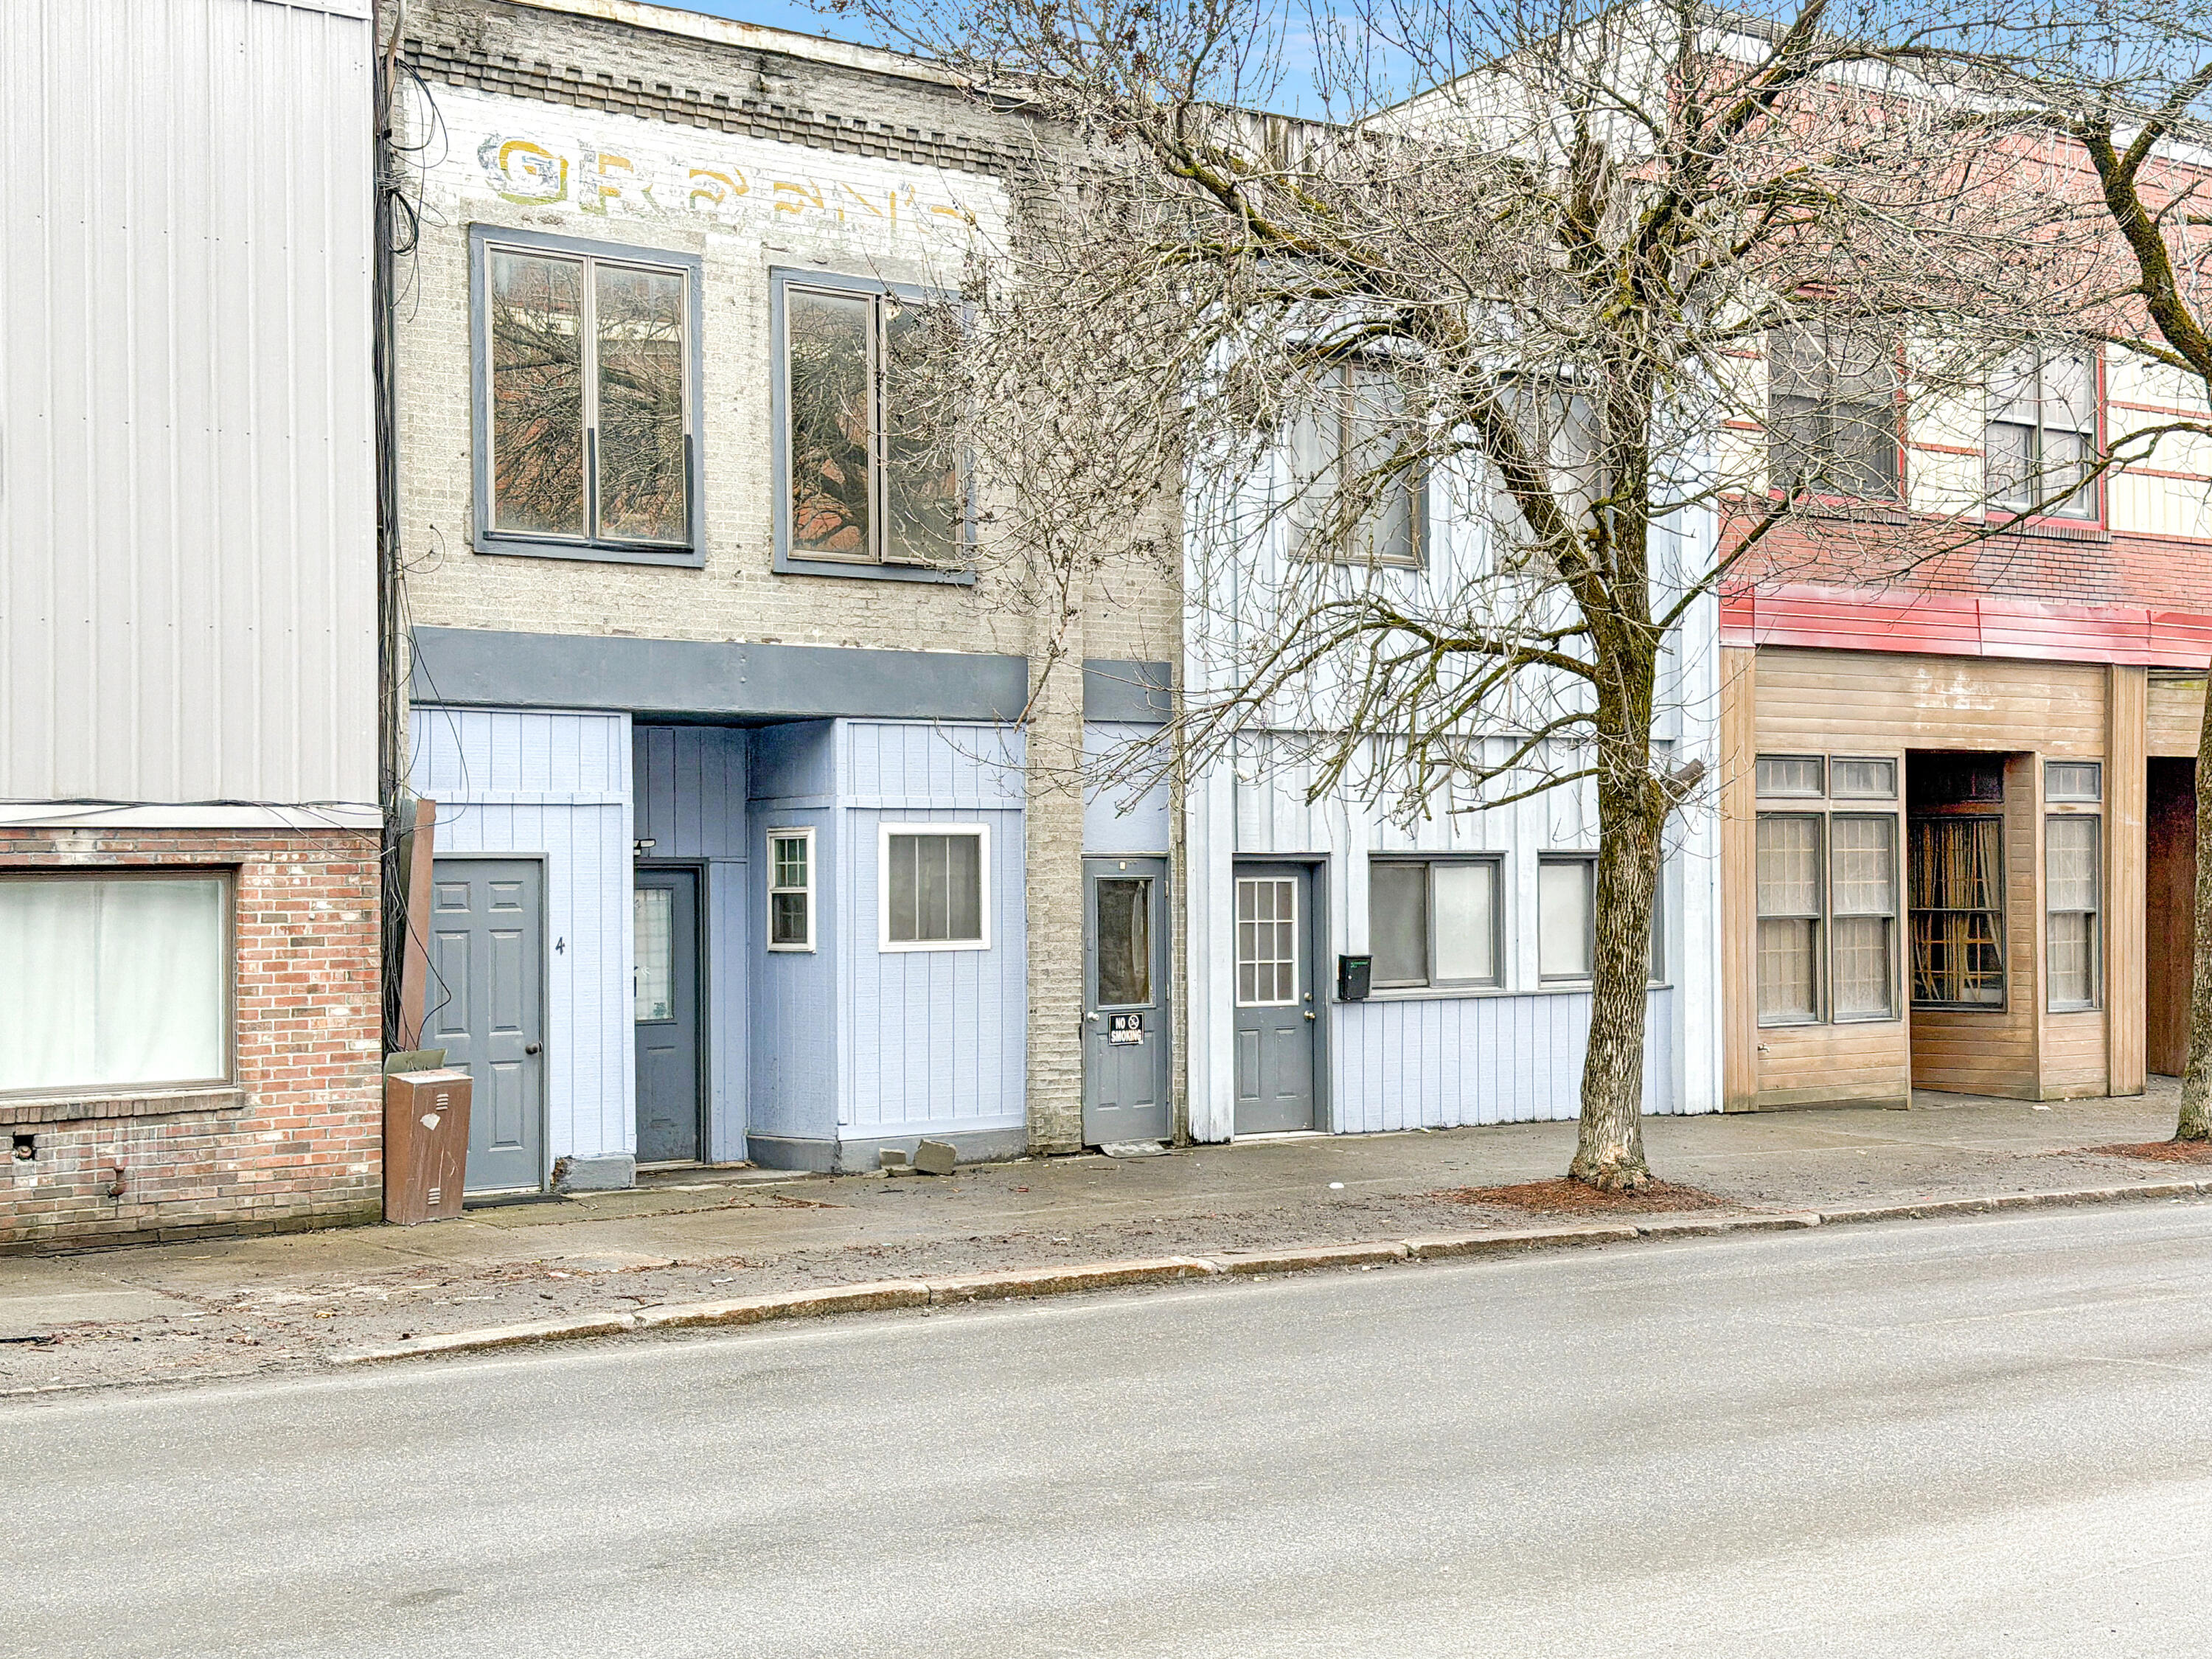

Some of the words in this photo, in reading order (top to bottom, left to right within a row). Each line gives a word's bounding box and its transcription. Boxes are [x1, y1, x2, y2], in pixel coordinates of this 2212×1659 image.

[555, 936, 566, 956] 4
[1115, 1017, 1126, 1029] NO
[1111, 1029, 1141, 1043] SMOKING
